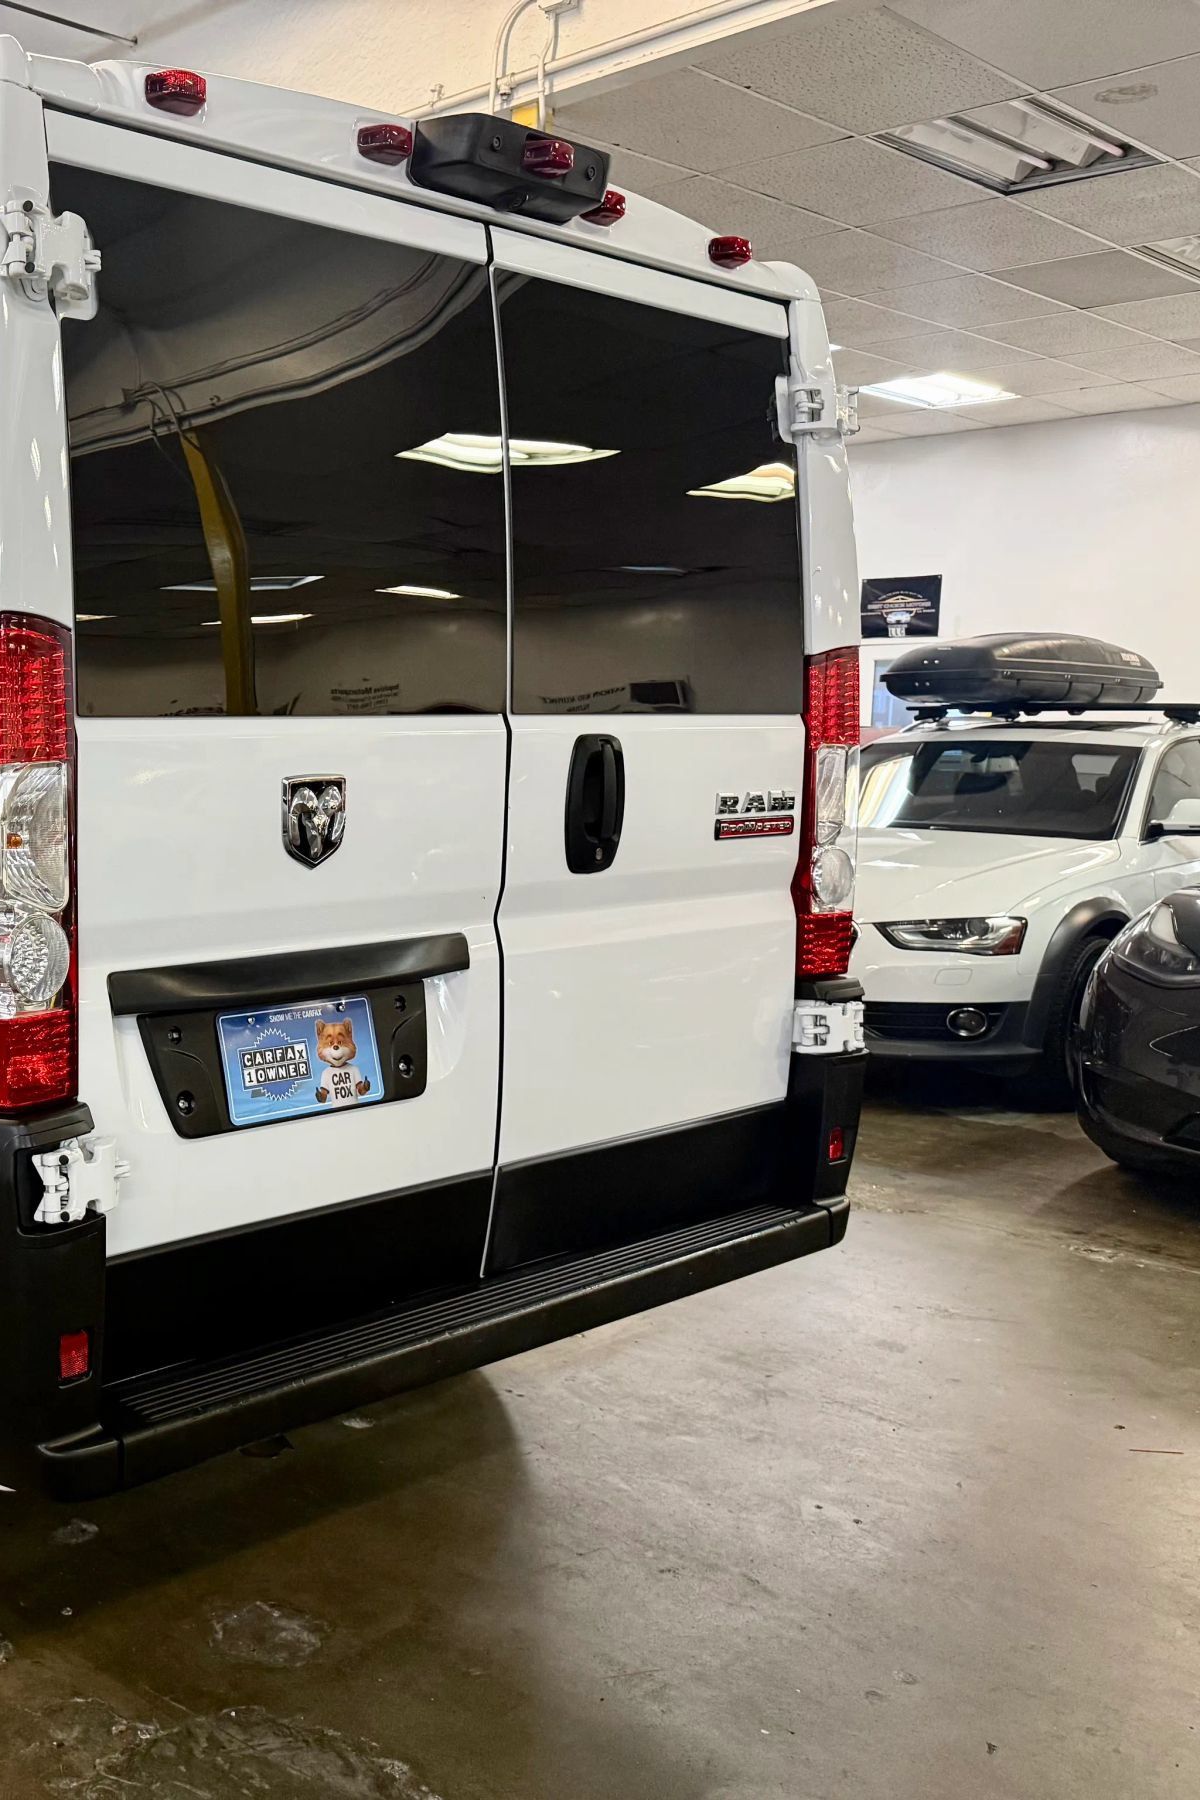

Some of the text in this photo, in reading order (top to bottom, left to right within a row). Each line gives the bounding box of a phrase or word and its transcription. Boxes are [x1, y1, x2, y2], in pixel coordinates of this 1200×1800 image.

[715, 790, 795, 815] RAM
[269, 1013, 285, 1023] SHOW
[293, 1011, 302, 1020] THE
[302, 1009, 322, 1018] CARFAX
[243, 1046, 305, 1068] CARFAX
[332, 1072, 352, 1086] CAR
[334, 1086, 354, 1100] FOX
